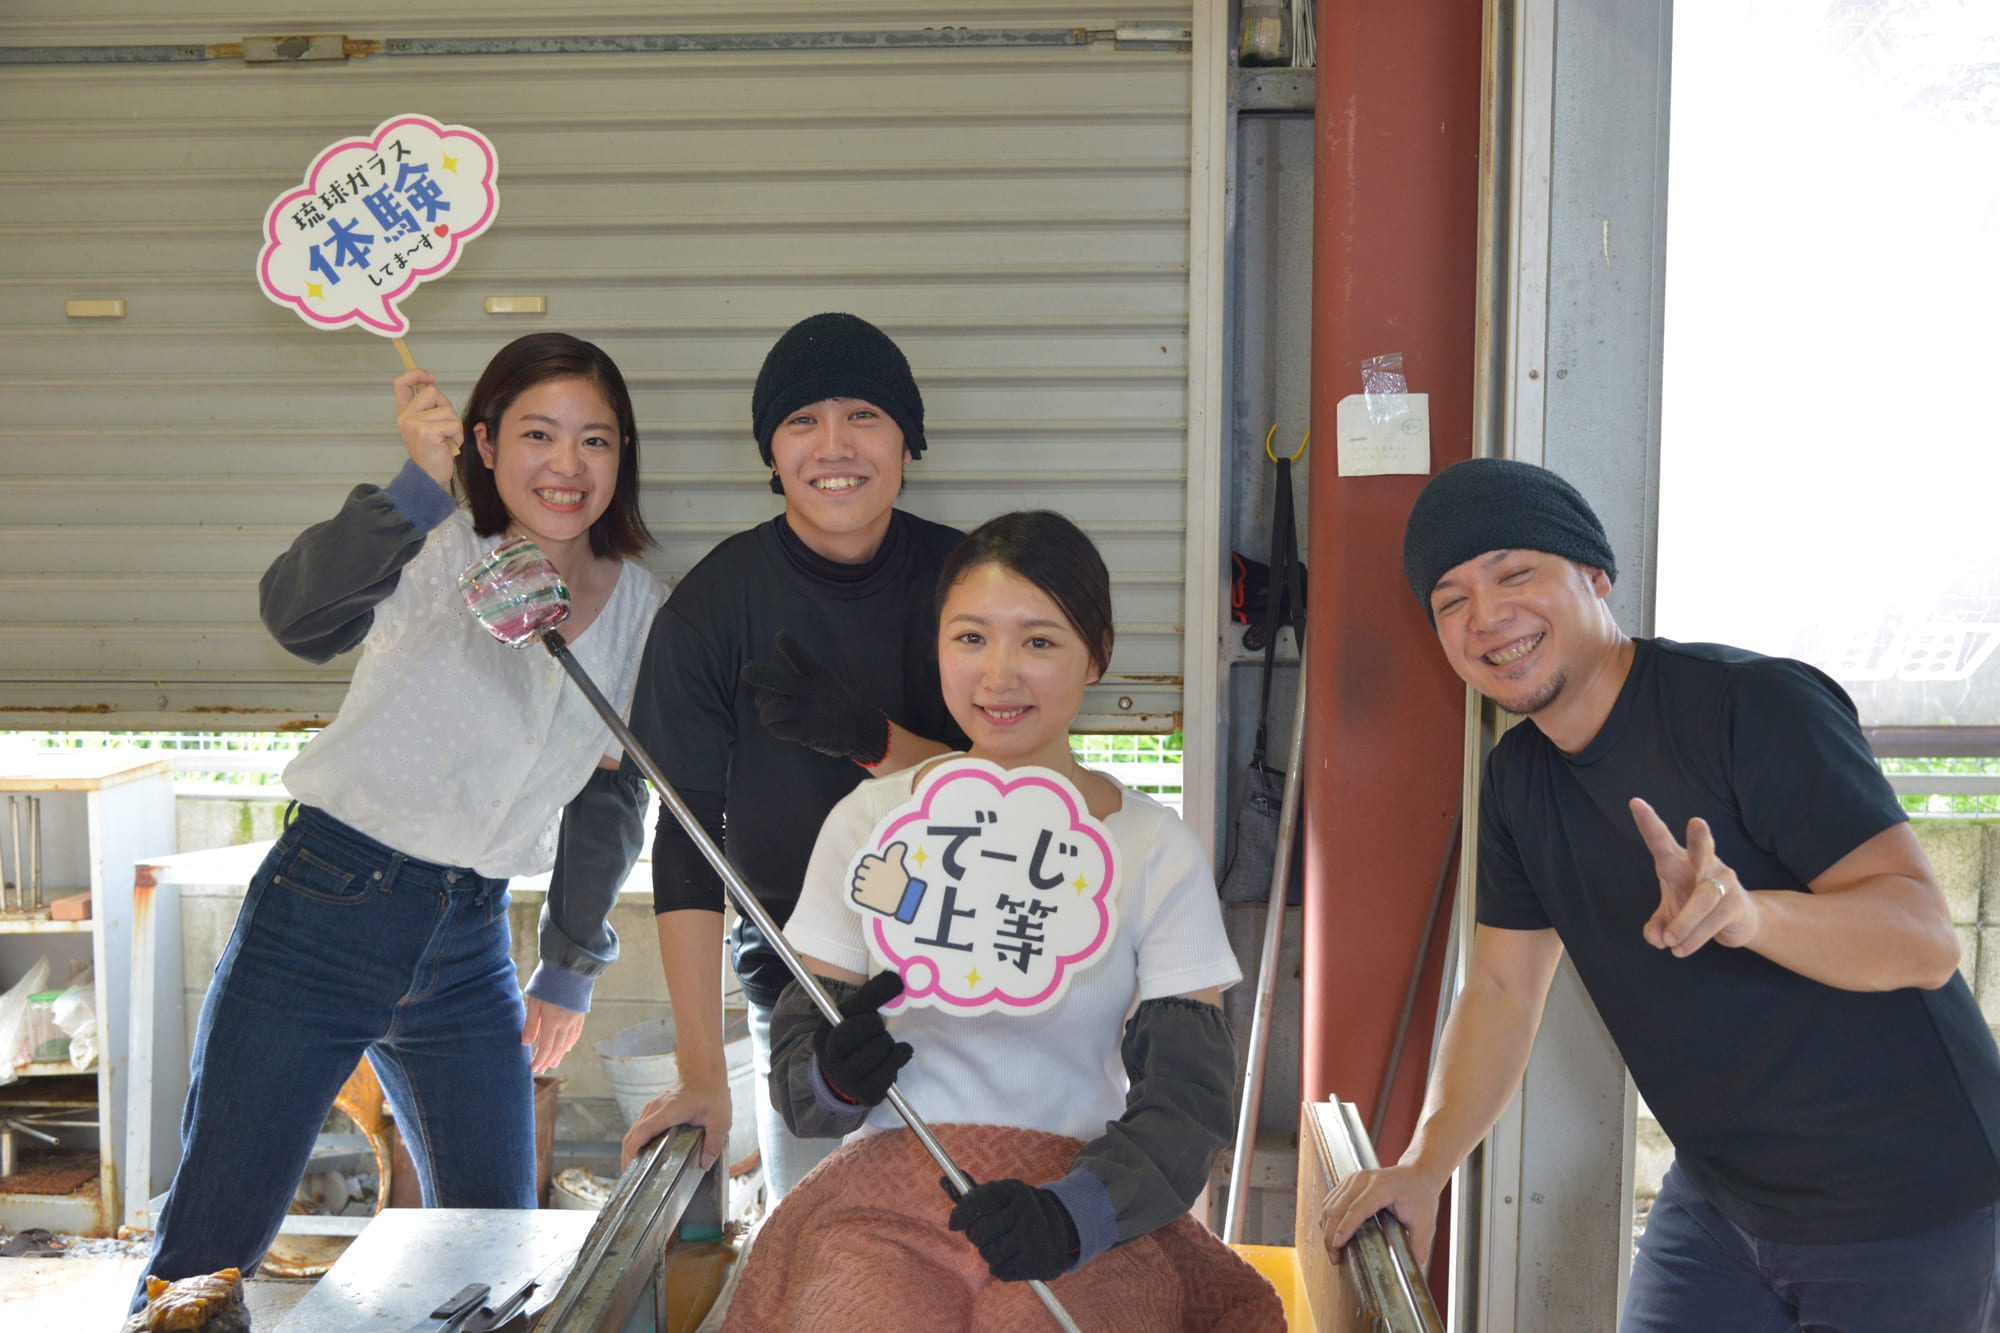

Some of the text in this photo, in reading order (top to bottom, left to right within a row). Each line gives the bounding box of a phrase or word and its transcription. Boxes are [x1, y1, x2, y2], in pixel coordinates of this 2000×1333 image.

[291, 140, 411, 230] 琉球ガラス
[309, 163, 451, 285] 体験
[927, 810, 1078, 889] でーじ
[914, 886, 1058, 974] 上等
